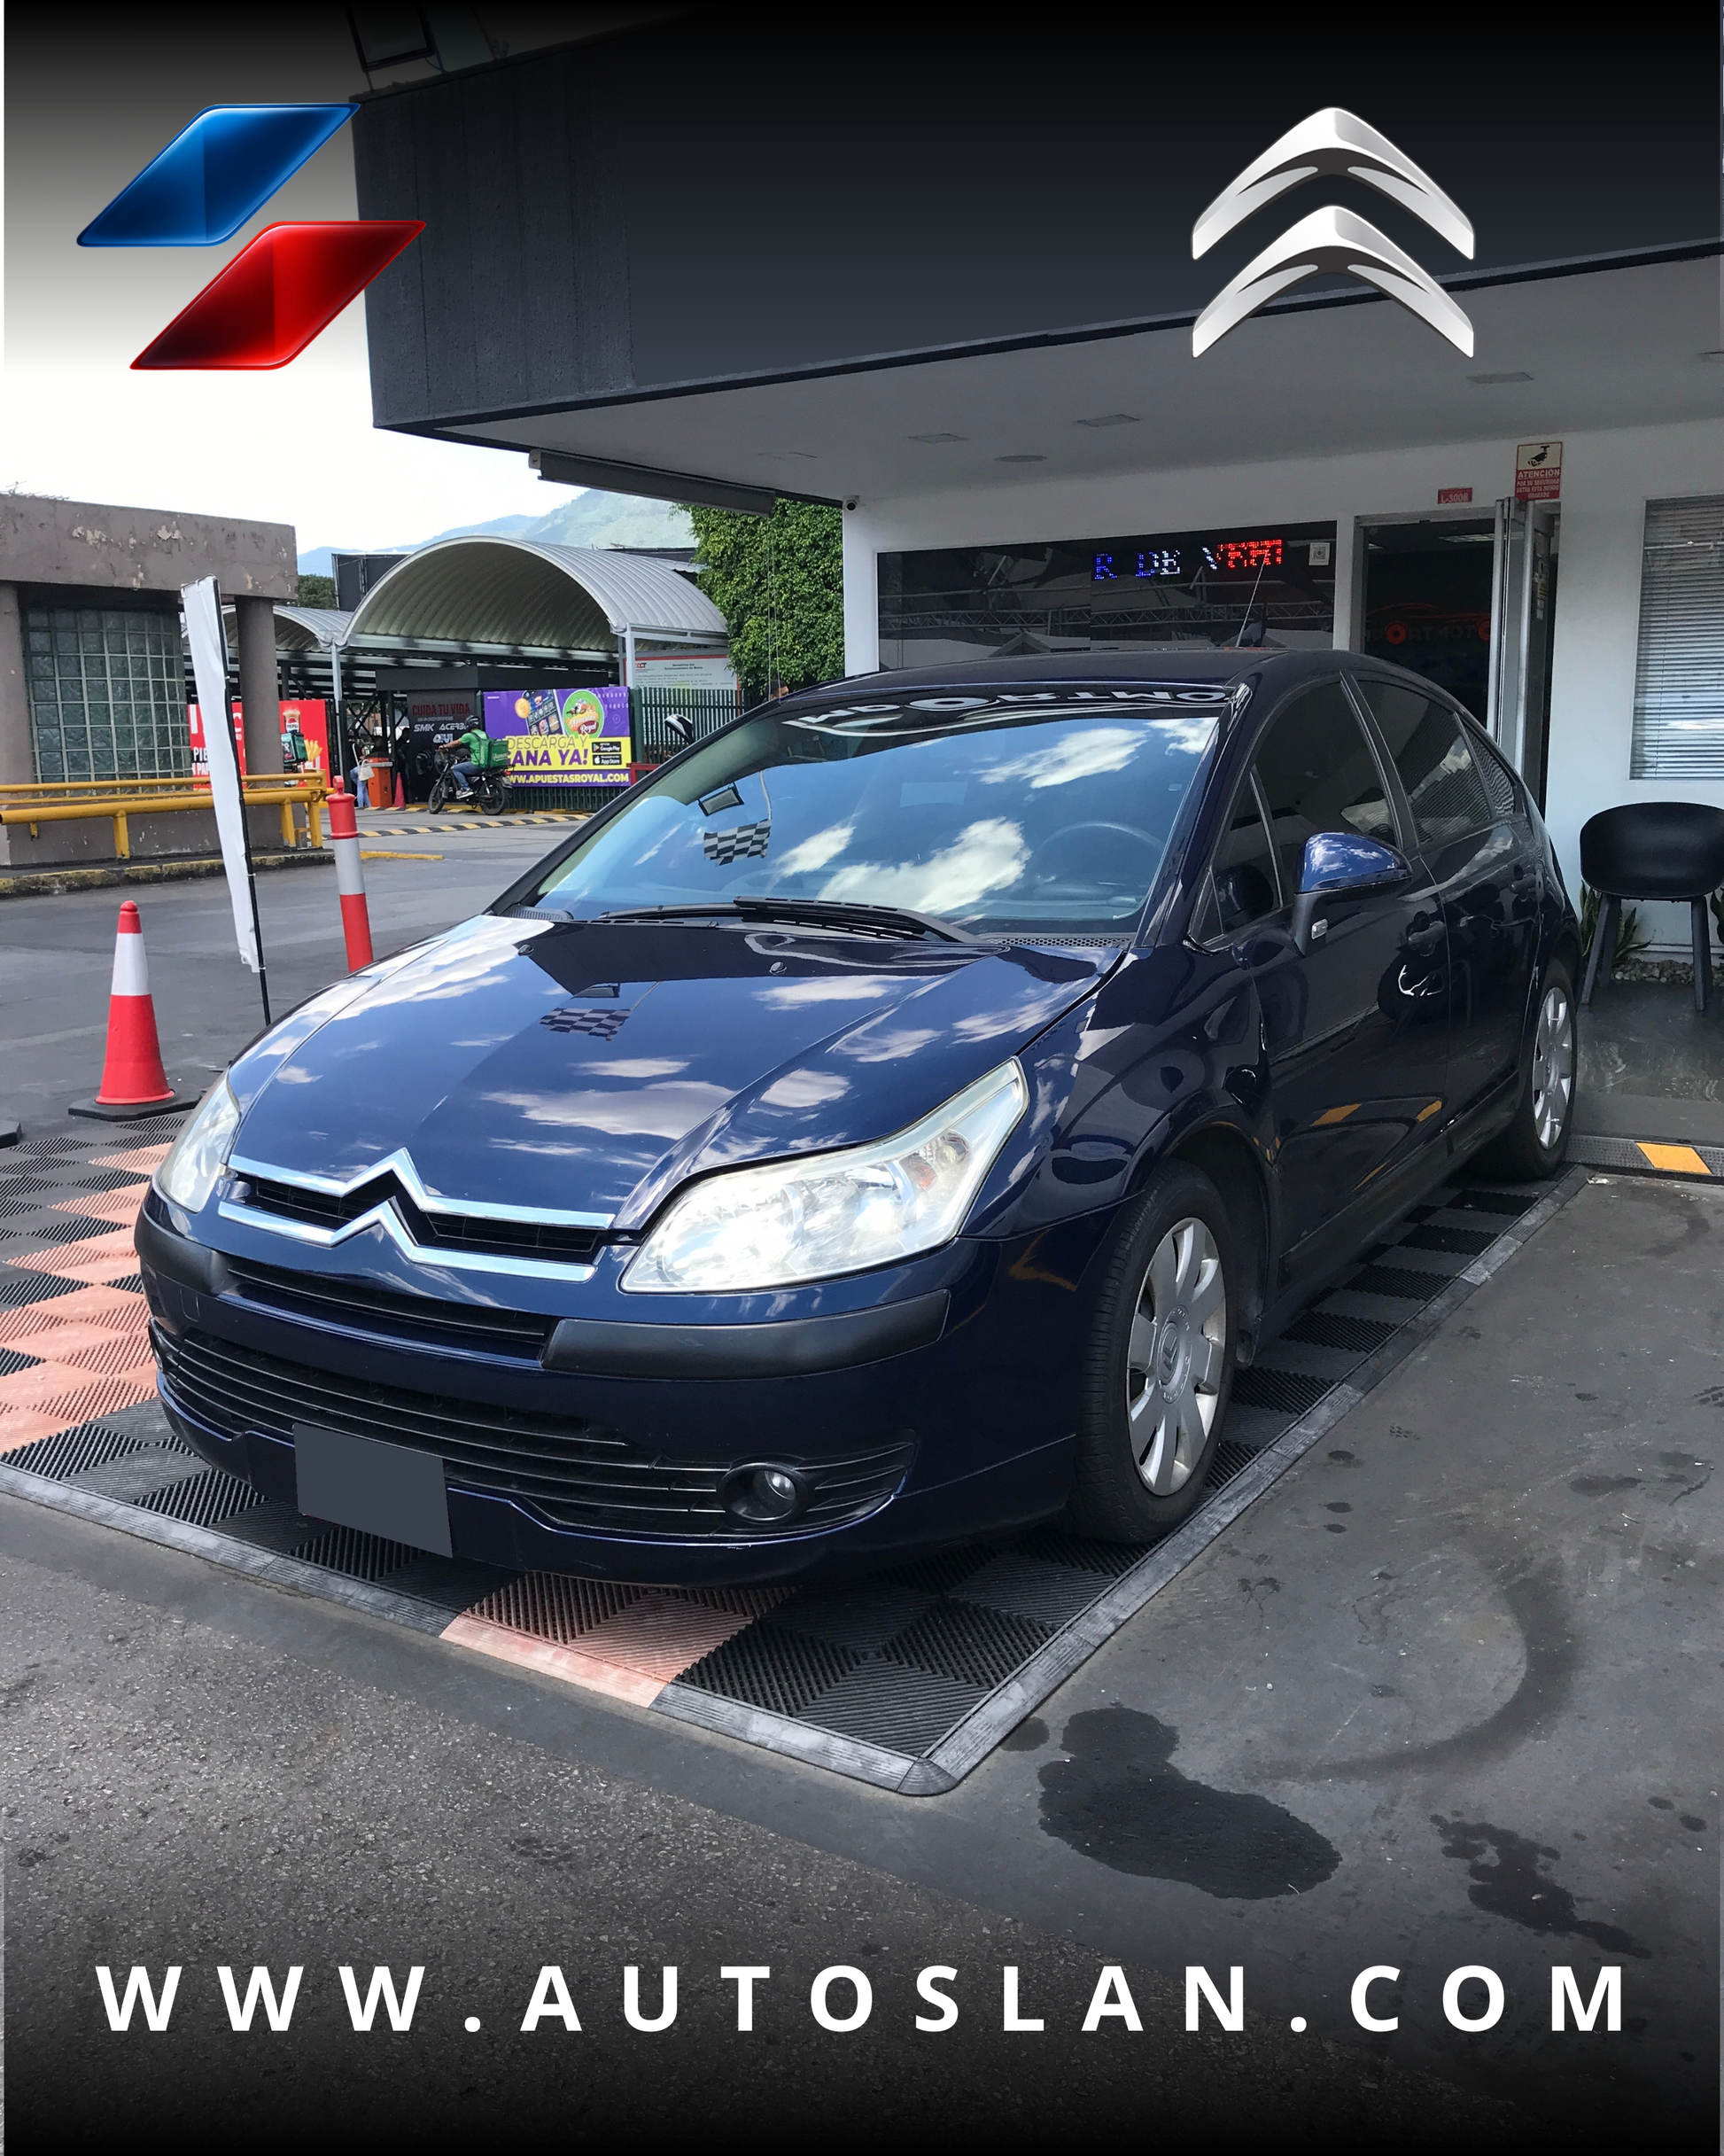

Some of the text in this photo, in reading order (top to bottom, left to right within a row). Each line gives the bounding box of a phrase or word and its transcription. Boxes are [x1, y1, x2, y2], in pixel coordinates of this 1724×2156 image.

[1441, 492, 1469, 503] L-3008
[412, 703, 470, 716] CUIDA TU VIDA
[414, 722, 467, 732] SMK ACERB
[579, 721, 597, 735] Royal
[508, 736, 588, 750] DESCARGA Y
[558, 749, 588, 766] YA!
[508, 773, 628, 784] WW.APUESTASROYAL.COM
